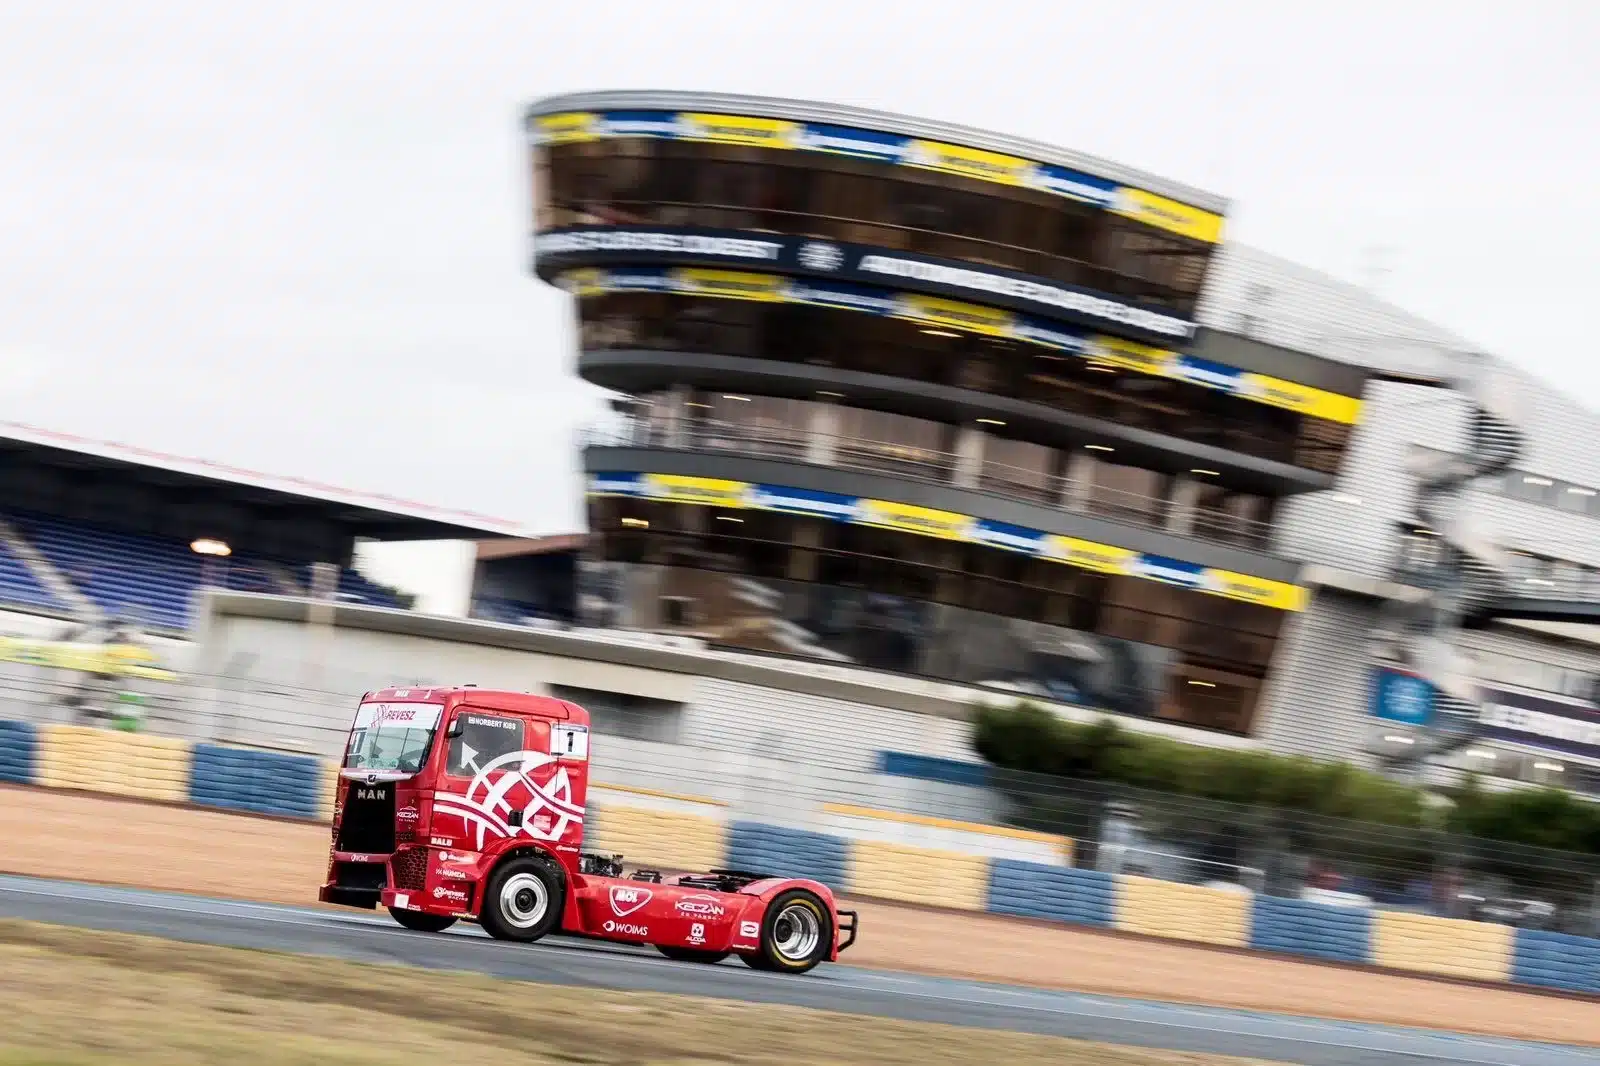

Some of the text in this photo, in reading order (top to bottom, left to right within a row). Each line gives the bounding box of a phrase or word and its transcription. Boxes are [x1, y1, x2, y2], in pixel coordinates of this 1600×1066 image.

[476, 718, 503, 728] NORBERT
[566, 731, 574, 752] 1
[357, 788, 386, 800] MAN
[615, 890, 639, 903] MOL
[615, 923, 649, 936] WOIMS
